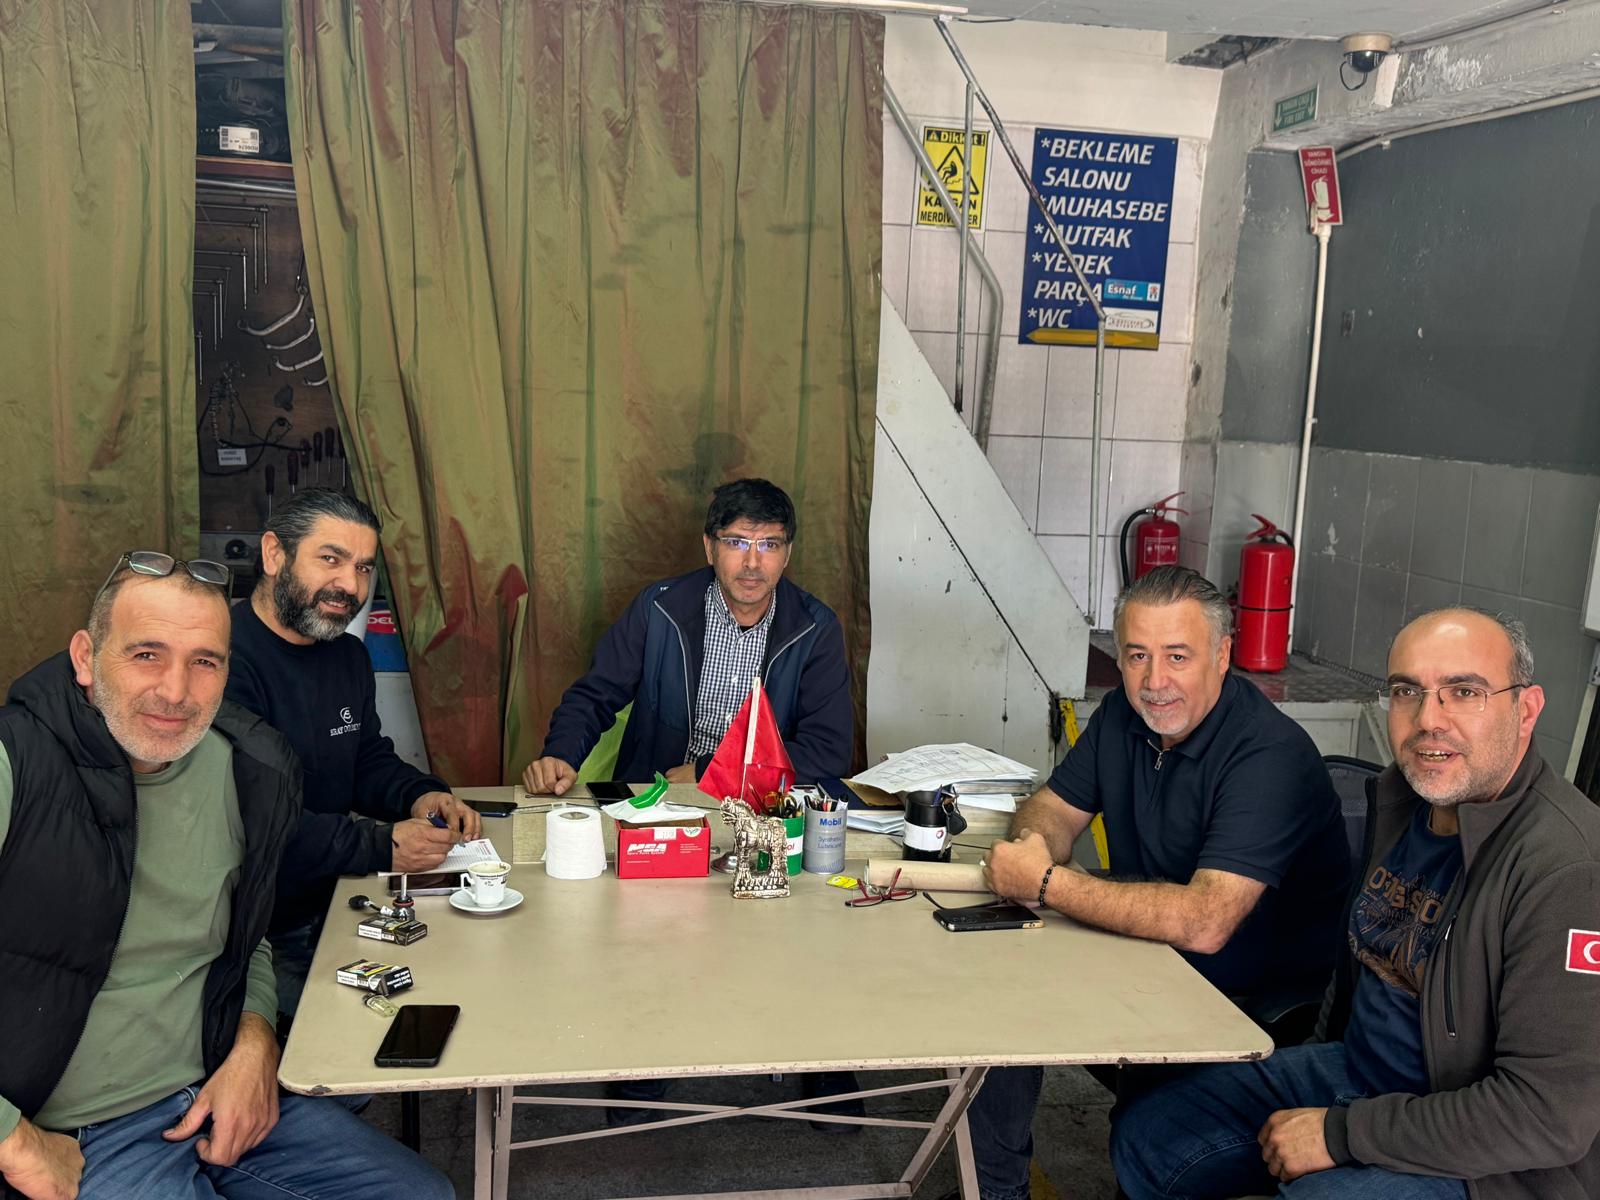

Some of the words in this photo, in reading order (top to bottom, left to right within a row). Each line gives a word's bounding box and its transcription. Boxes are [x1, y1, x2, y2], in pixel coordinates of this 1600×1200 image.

[1042, 166, 1132, 192] SALONU
[1107, 283, 1137, 295] Esnaf
[820, 817, 842, 826] Mobil
